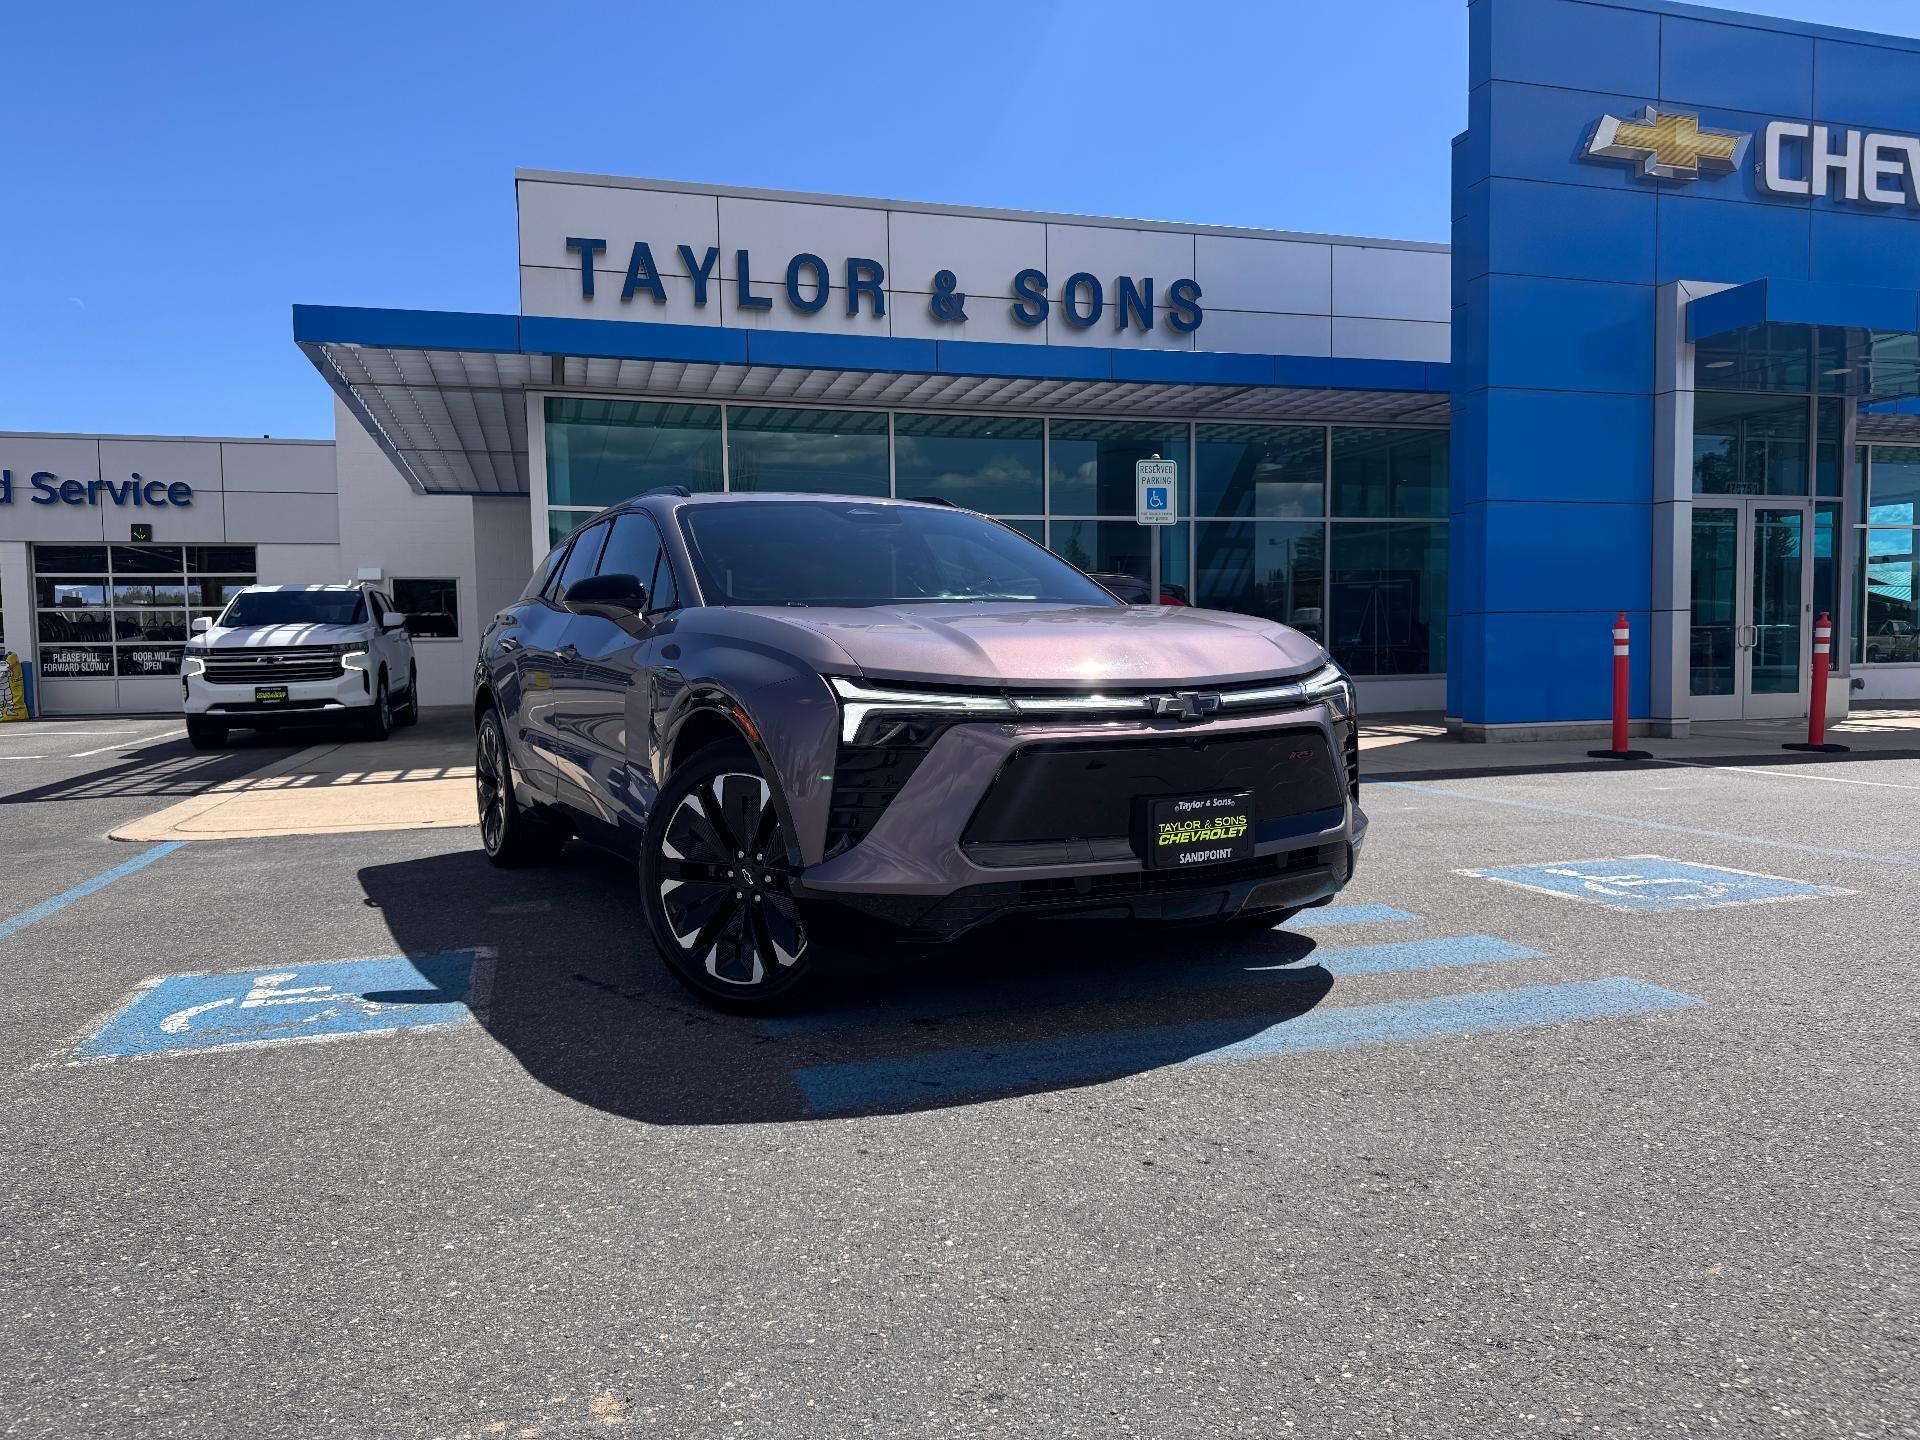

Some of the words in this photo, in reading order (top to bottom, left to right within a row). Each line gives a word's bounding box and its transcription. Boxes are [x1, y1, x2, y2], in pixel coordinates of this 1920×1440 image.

[566, 236, 886, 318] TAYLOR
[927, 269, 968, 323] &
[1012, 268, 1204, 334] SONS
[1140, 466, 1172, 474] RESERVED
[1141, 477, 1172, 485] PARKING
[31, 470, 194, 507] Service
[53, 653, 80, 663] PLEASE
[82, 653, 100, 662] PULL
[132, 652, 153, 661] DOOR
[154, 651, 171, 661] WILL
[43, 663, 80, 672] FORWARD
[81, 662, 110, 672] SLOWLY
[143, 662, 163, 671] OPEN
[1178, 799, 1205, 811] Taylor
[1212, 798, 1232, 807] Sons
[1158, 820, 1201, 833] TAYLOR
[1204, 819, 1212, 829] &
[1214, 815, 1247, 827] SONS
[1158, 826, 1247, 846] CHEVROLET
[1179, 848, 1233, 864] SANDPOINT
